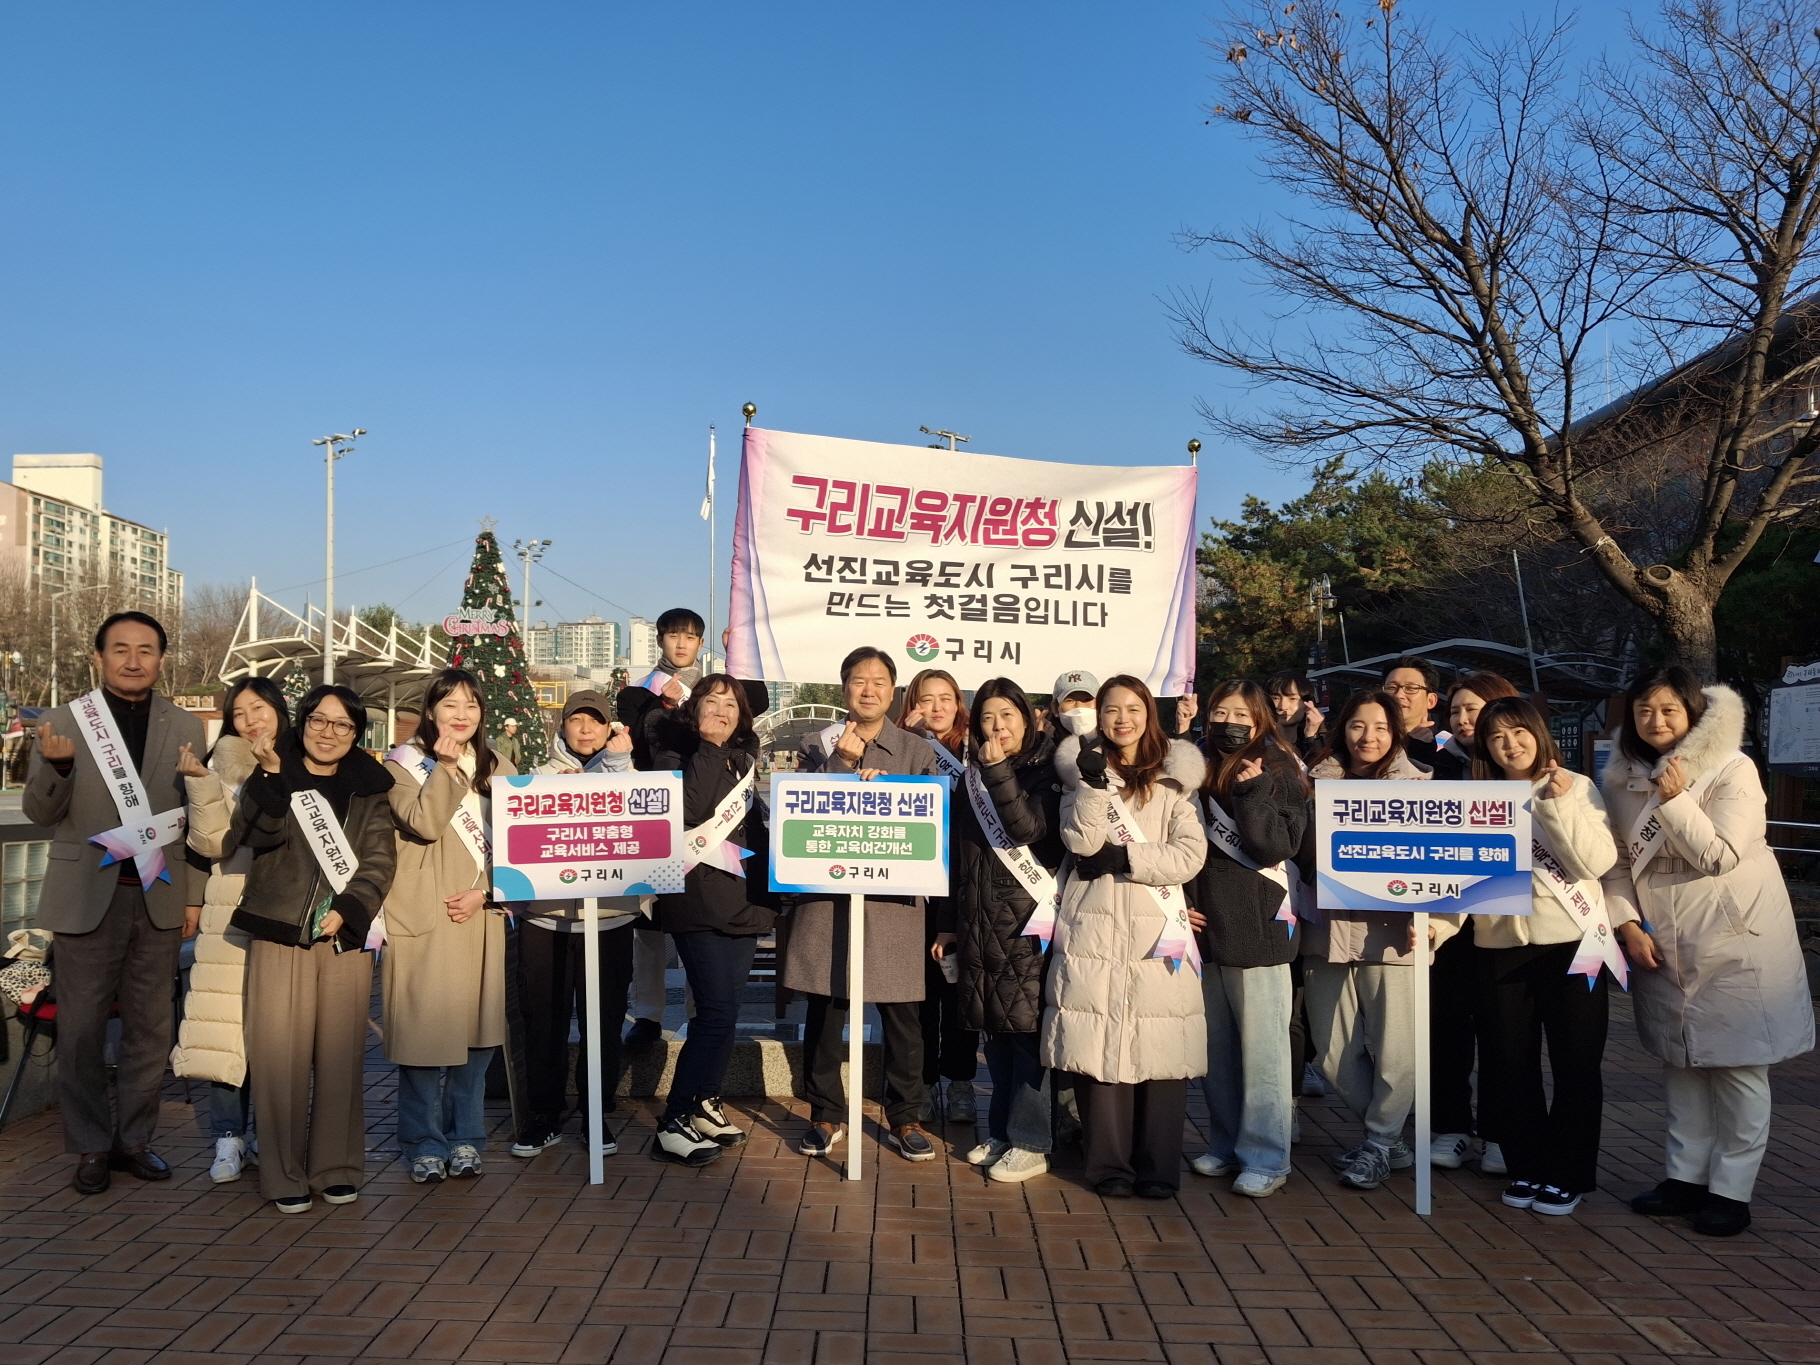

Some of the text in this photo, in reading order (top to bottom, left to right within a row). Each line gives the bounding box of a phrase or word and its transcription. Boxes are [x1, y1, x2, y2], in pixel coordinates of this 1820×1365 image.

[785, 474, 1153, 550] 구리교육지원청 신설!
[803, 553, 1133, 594] 선진교육도시 구리시를
[457, 606, 498, 622] MERRY
[826, 591, 1108, 627] 만드는 첫걸음입니다
[945, 638, 1021, 664] 구리시
[101, 743, 128, 780] 구리를
[118, 782, 140, 808] 향해
[507, 788, 669, 817] 구리교육지원청 신설!
[714, 800, 742, 829] 신설!
[785, 790, 934, 817] 구리교육지원청 신설!
[1332, 799, 1513, 826] 구리교육지원청 신설!
[546, 825, 633, 841] 구리시 맞춤형
[812, 824, 907, 840] 교육자치 강화를
[540, 841, 640, 859] 교육서비스 제공
[805, 839, 913, 856] 통한 교육여건개선
[1337, 844, 1510, 863] 선진교육도시 구리를 향해
[580, 868, 623, 882] 구리시
[849, 866, 889, 880] 구리시
[1018, 859, 1042, 885] 향해
[1411, 882, 1460, 897] 구리시
[1569, 890, 1591, 917] 제공
